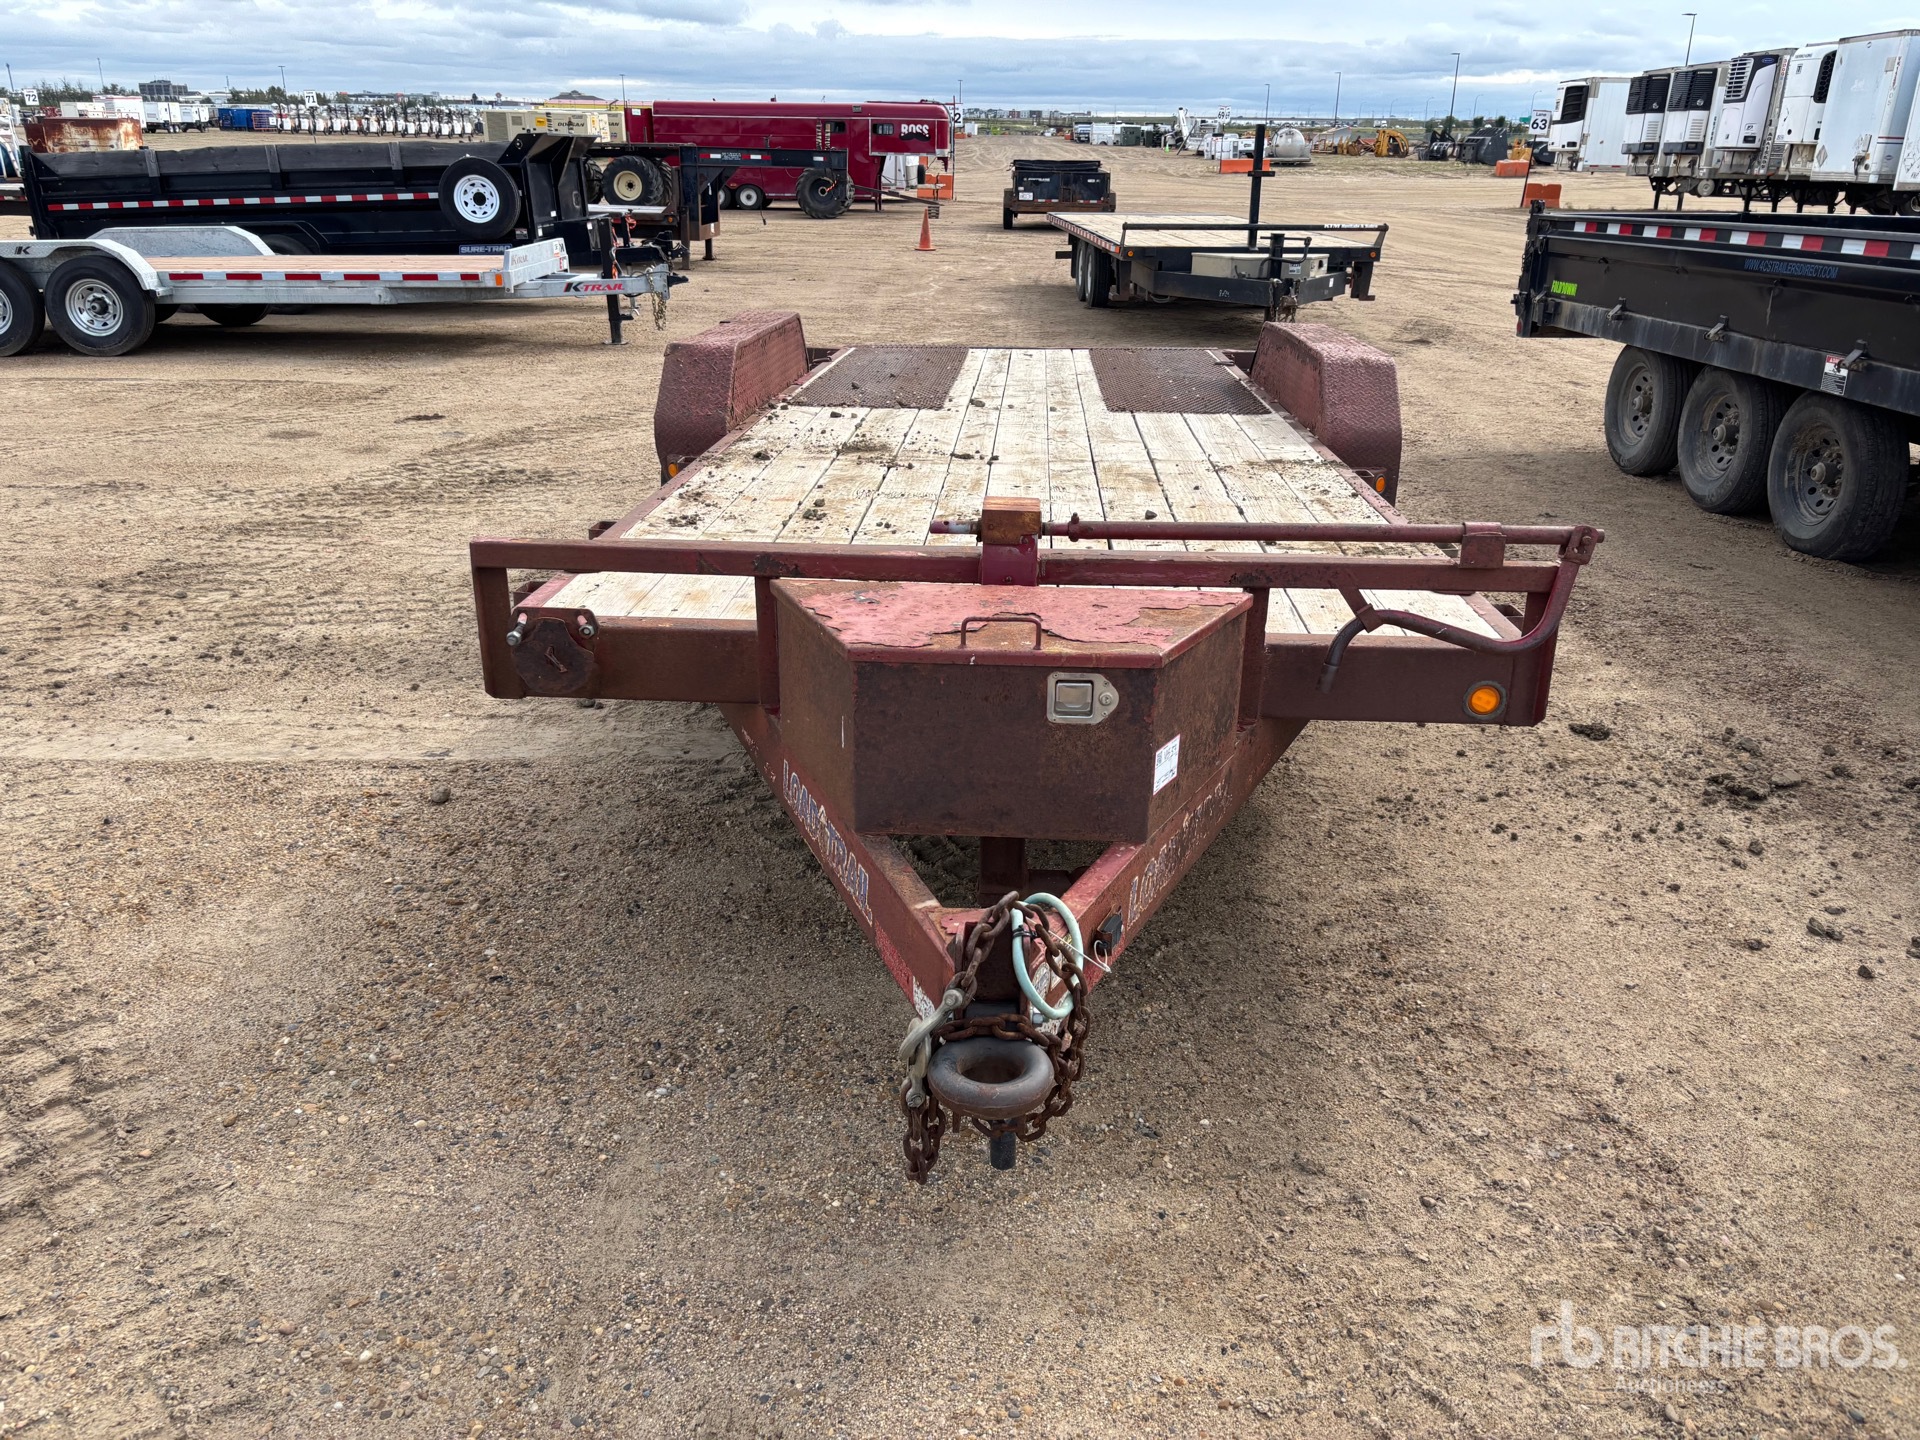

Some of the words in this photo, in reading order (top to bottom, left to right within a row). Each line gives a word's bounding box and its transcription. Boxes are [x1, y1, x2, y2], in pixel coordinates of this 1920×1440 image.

[25, 94, 37, 102] 72
[305, 95, 316, 103] 71
[1531, 119, 1547, 130] 63
[1744, 258, 1839, 278] WWW.4CSTRAILERSDIRECT.COM
[783, 758, 819, 841] LOAD
[819, 818, 873, 928] TRAIL
